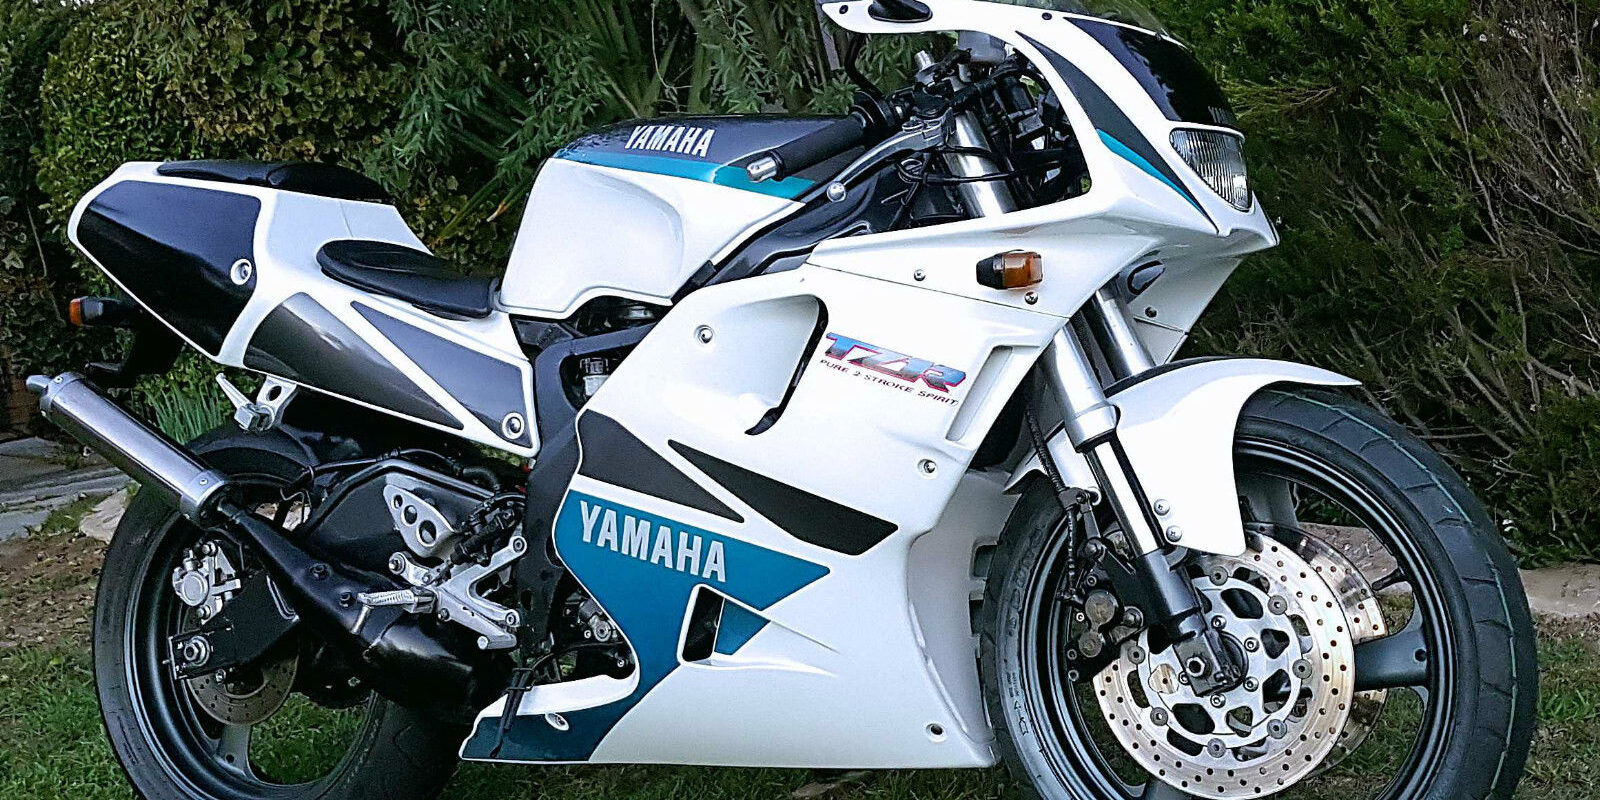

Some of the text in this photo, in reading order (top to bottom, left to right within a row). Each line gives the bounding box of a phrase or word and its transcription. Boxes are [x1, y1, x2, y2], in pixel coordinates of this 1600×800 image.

[624, 125, 715, 157] YAMAHA
[820, 359, 850, 374] PURE
[864, 373, 915, 393] STROKE
[917, 390, 959, 407] SPIRIT
[825, 332, 966, 393] TZR
[579, 500, 726, 583] YAMAHA
